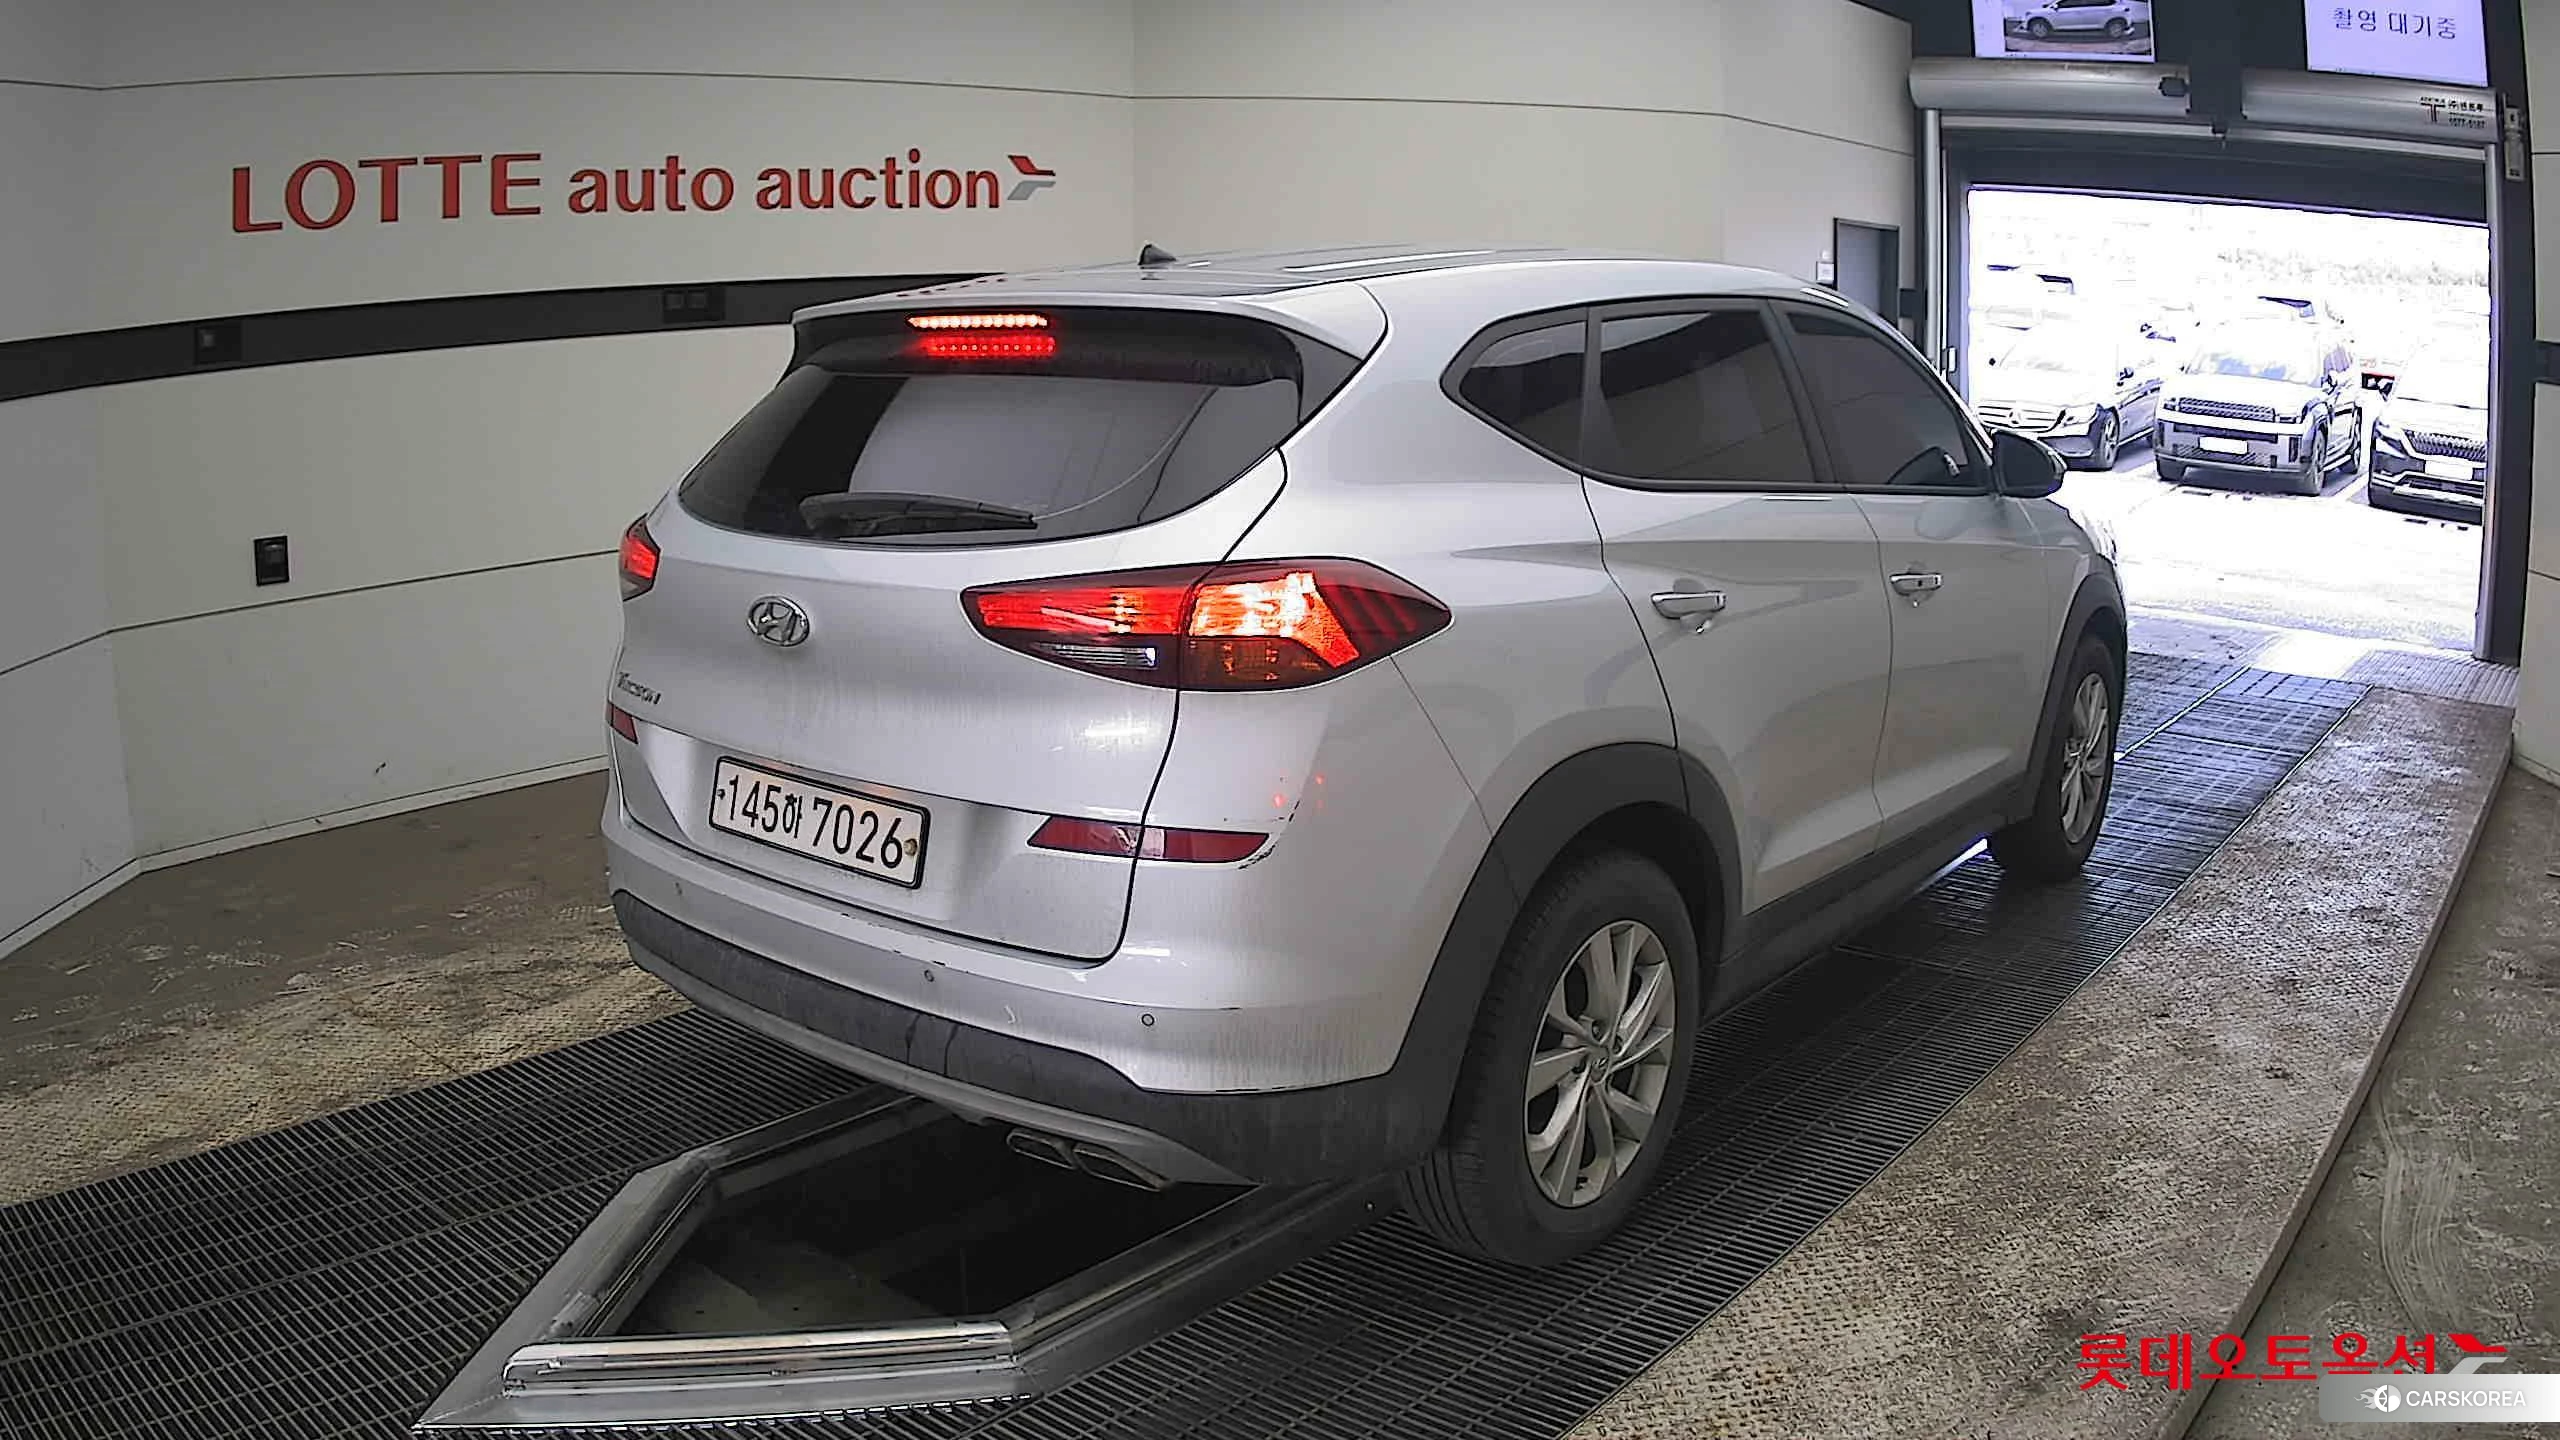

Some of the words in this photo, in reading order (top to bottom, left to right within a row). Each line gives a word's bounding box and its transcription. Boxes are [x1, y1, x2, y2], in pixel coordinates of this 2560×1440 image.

[2334, 7, 2377, 32] 촬영
[2388, 12, 2456, 40] 대기중
[233, 153, 541, 233] LOTTE
[566, 154, 735, 213] auto
[755, 148, 1001, 210] auction
[729, 774, 803, 839] 145하
[812, 796, 904, 869] 7026
